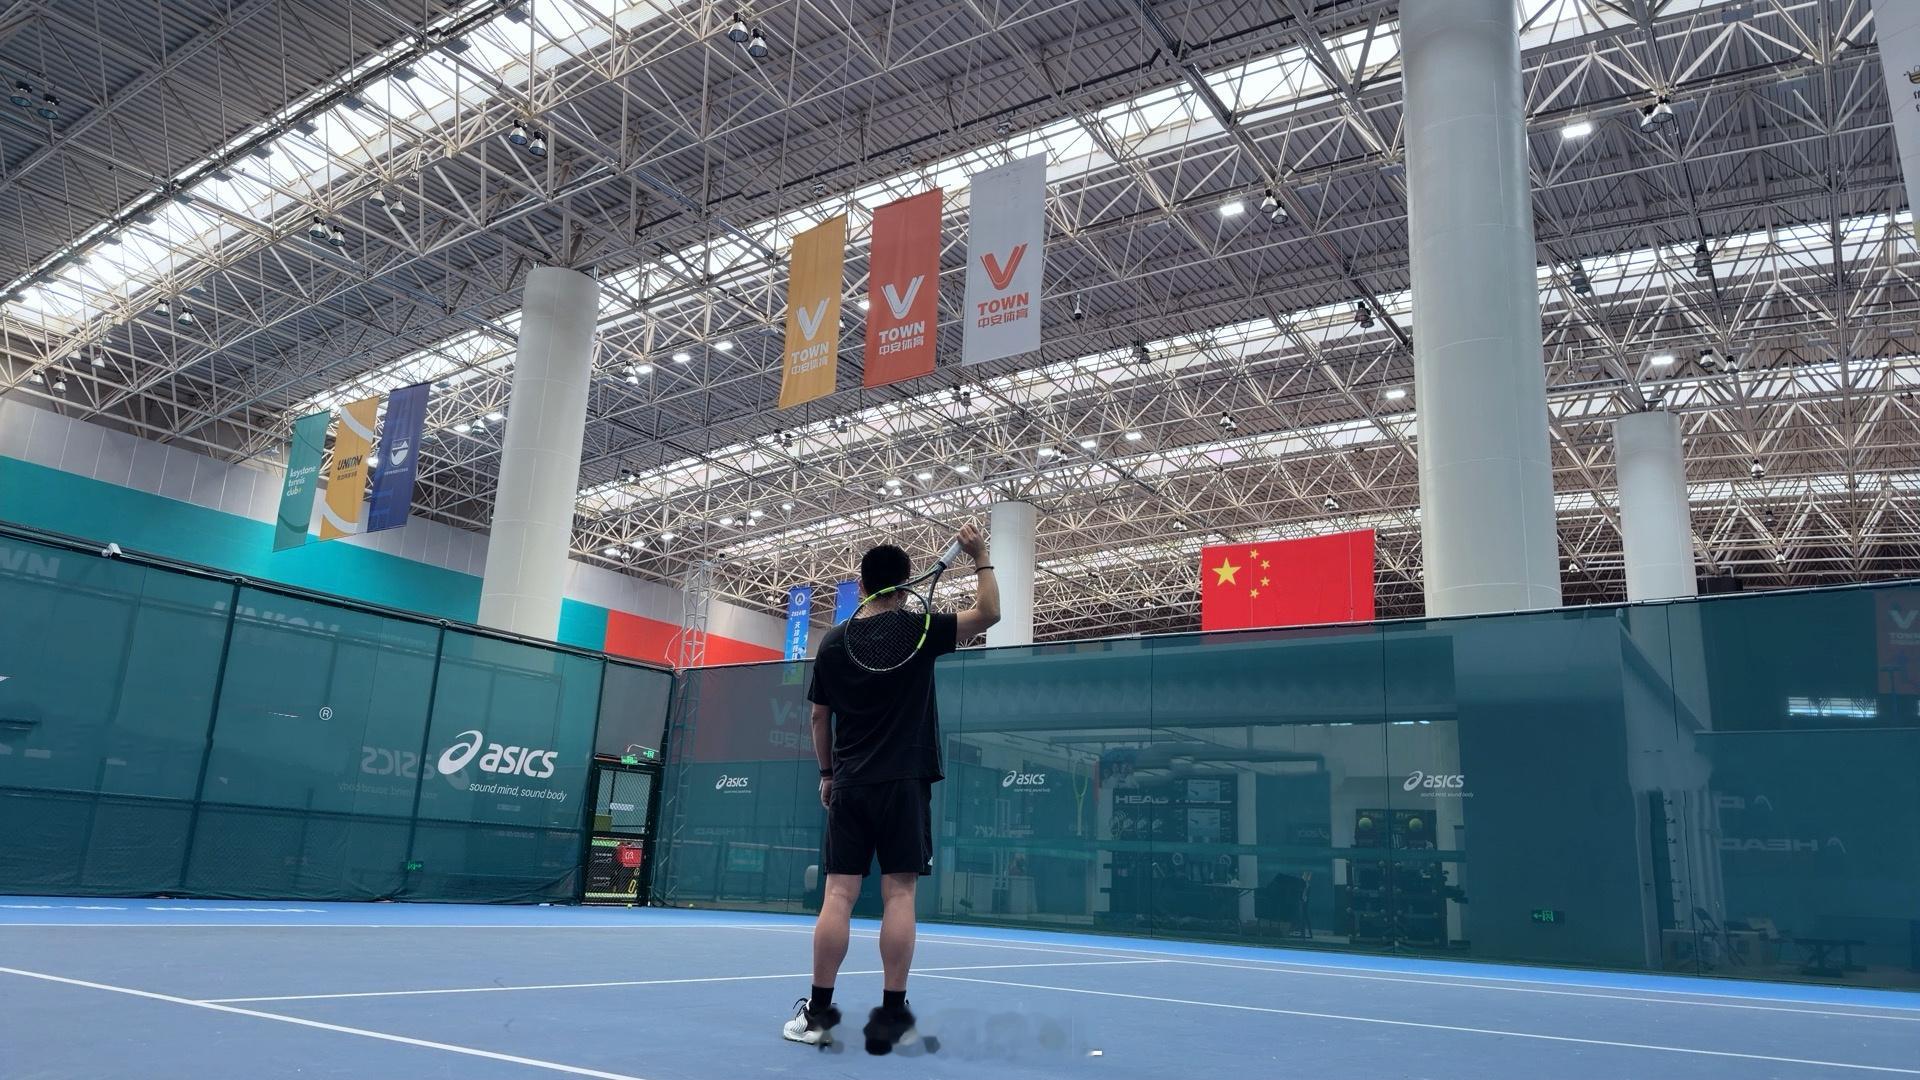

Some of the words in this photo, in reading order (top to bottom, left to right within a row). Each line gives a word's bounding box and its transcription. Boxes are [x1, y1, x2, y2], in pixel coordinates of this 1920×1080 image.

[978, 292, 1029, 316] TOWN
[879, 320, 925, 344] TOWN
[791, 342, 829, 364] TOWN
[469, 783, 497, 794] sound
[520, 787, 546, 799] sound
[546, 790, 567, 803] body
